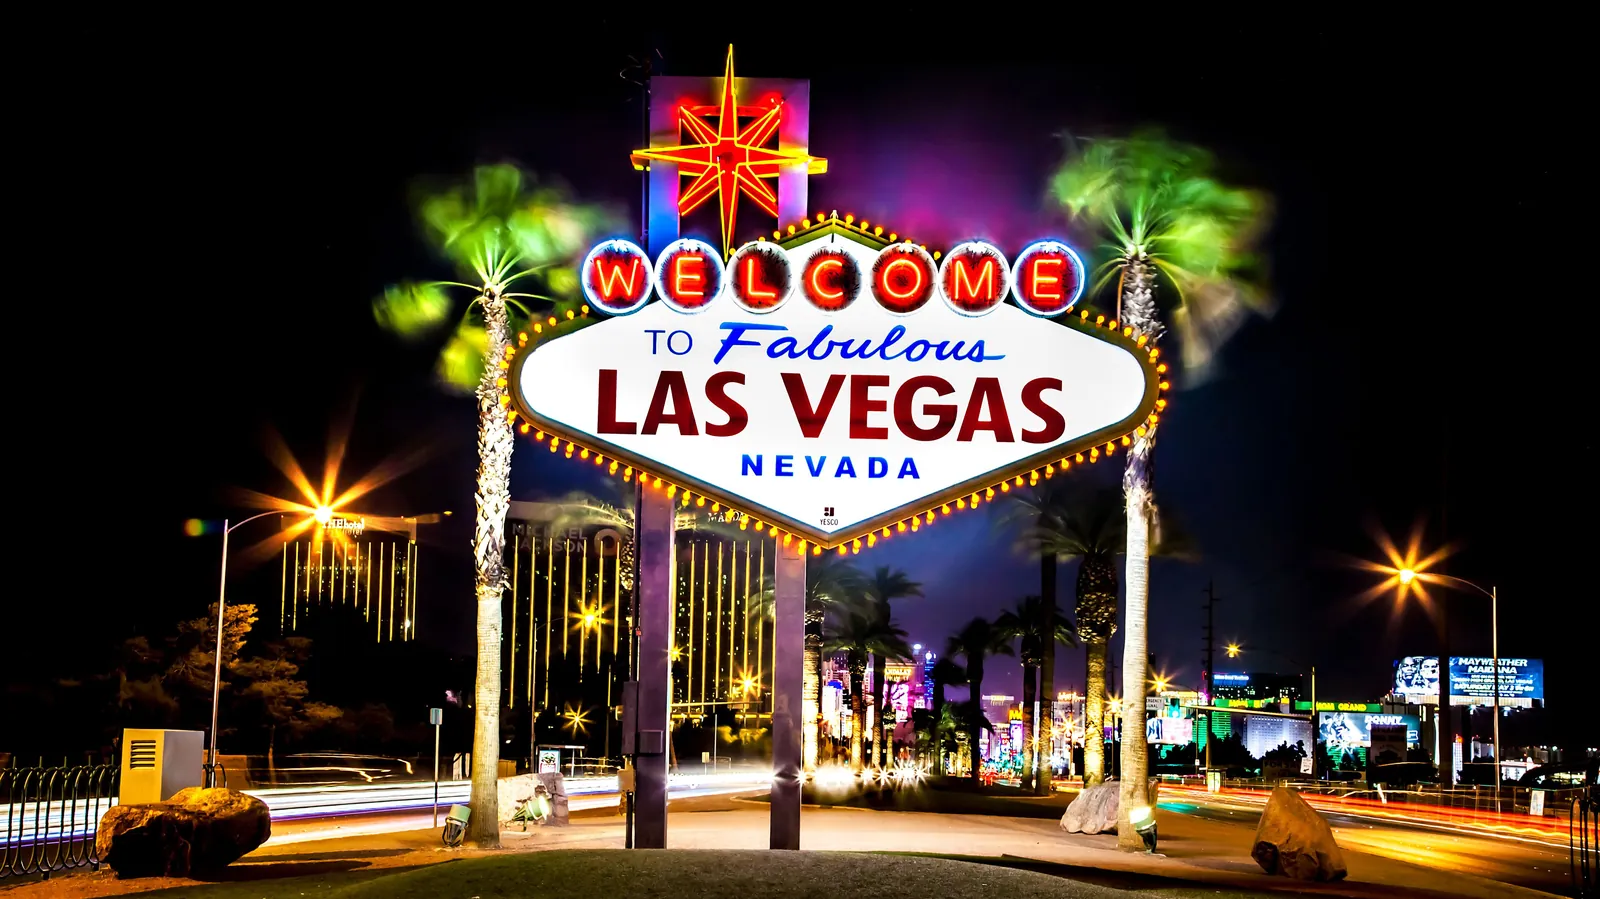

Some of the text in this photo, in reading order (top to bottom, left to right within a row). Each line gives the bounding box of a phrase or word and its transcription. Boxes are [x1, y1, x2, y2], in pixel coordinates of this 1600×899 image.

[592, 254, 1066, 303] WELCOME
[644, 321, 1006, 364] TO Fabulous
[596, 368, 1066, 444] LAS VEGAS
[740, 453, 920, 479] NEVADA
[819, 518, 839, 526] YESCO
[1458, 657, 1528, 667] MAYWEATHER
